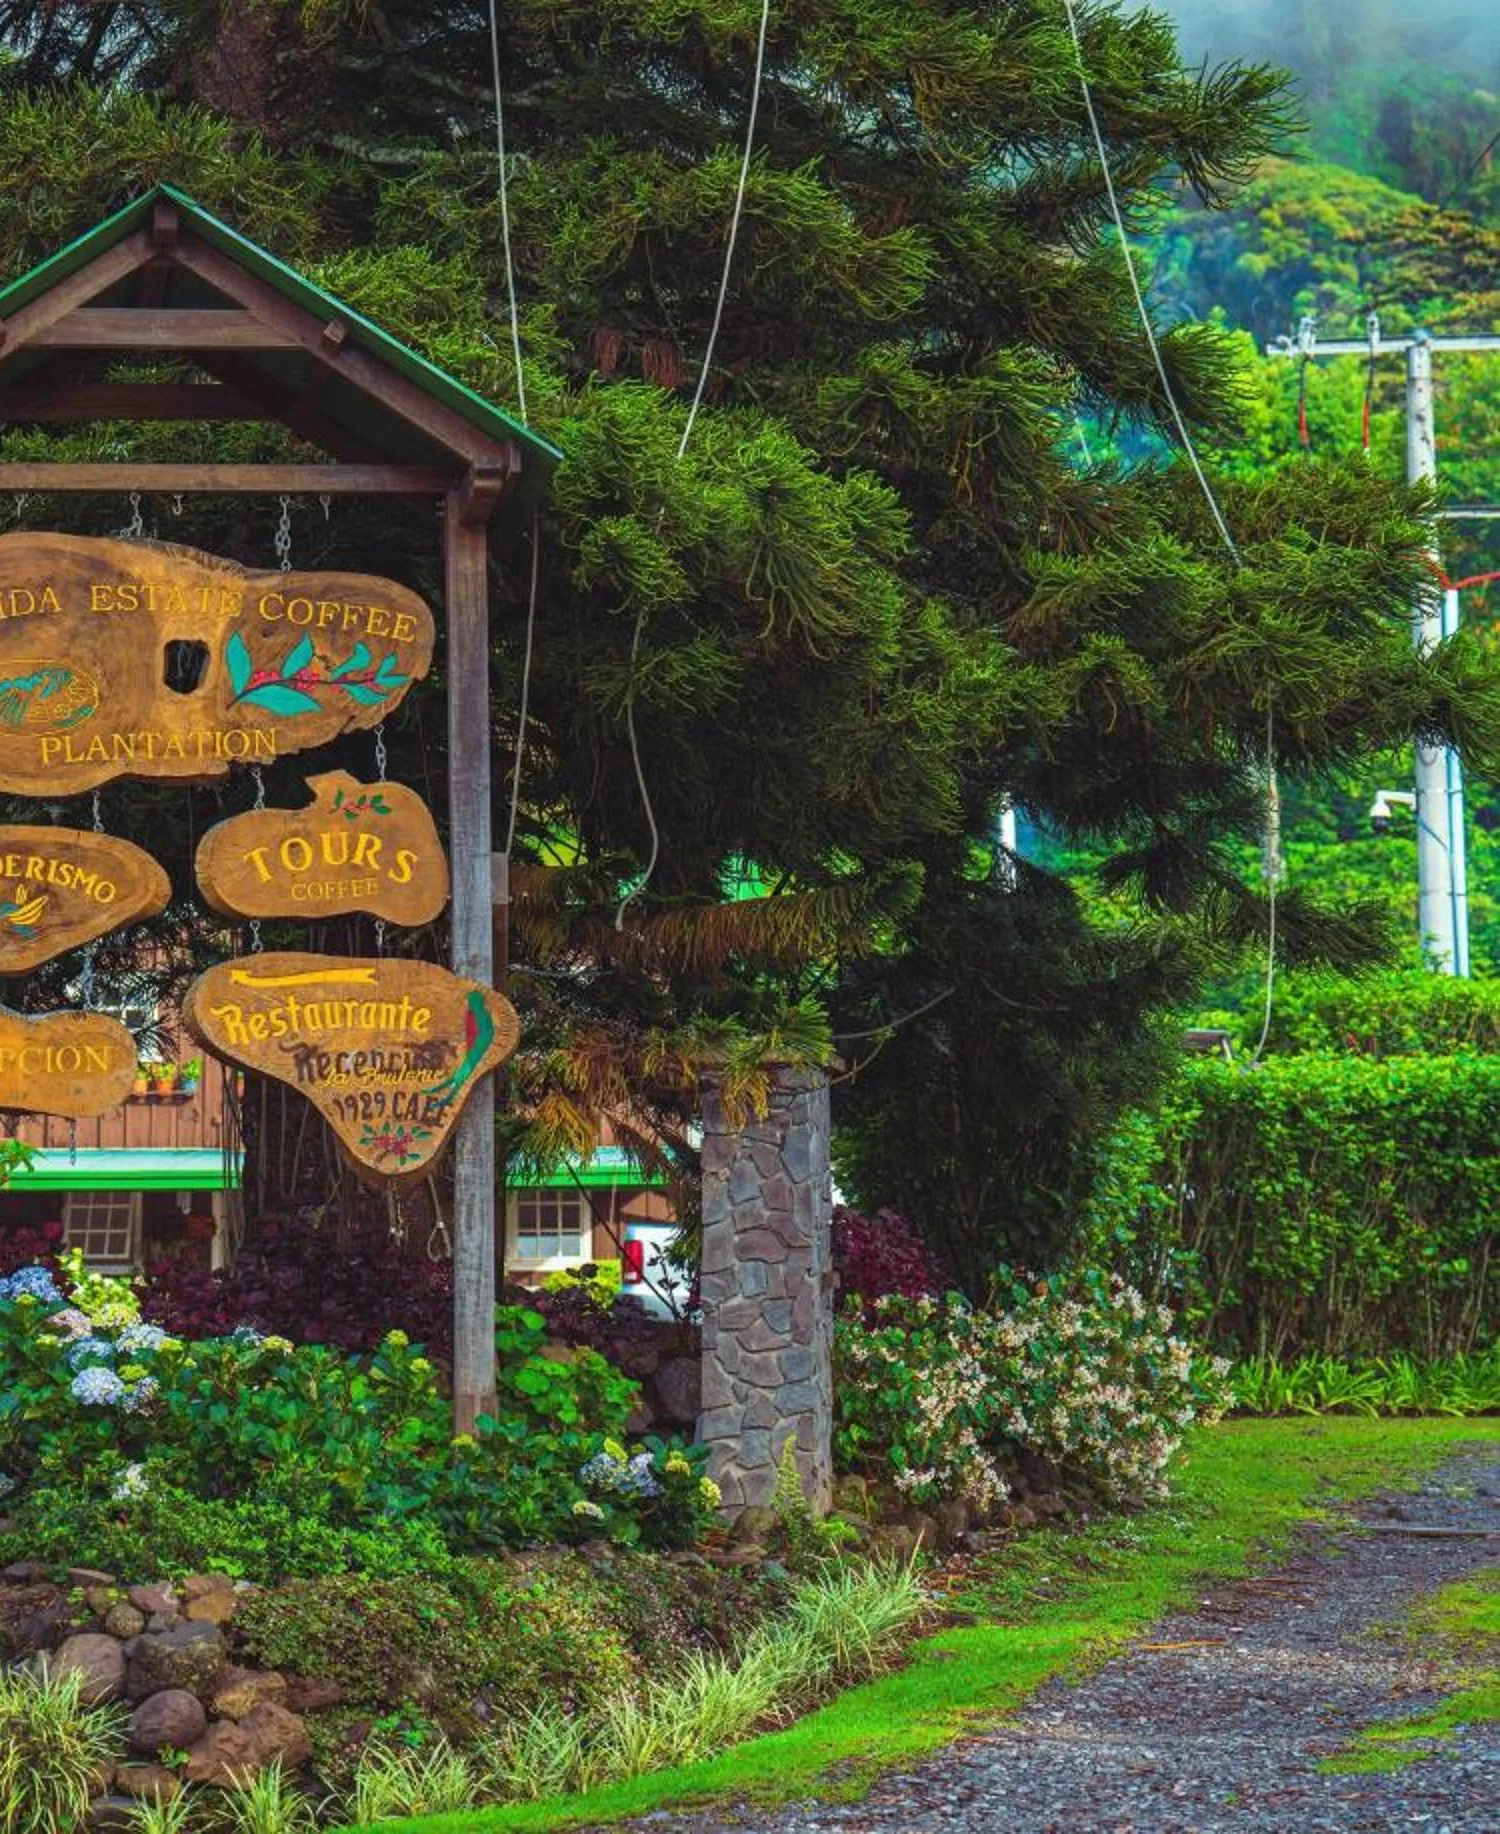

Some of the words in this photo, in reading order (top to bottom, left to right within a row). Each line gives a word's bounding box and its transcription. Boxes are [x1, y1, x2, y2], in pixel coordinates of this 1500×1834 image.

[90, 583, 243, 618] ESTATE
[258, 592, 419, 644] COFFEE
[40, 728, 277, 767] PLANTATION
[243, 831, 420, 885] TOURS
[290, 877, 380, 902] COFFEE
[211, 994, 433, 1045] Restaurante
[332, 1091, 387, 1123] 1929
